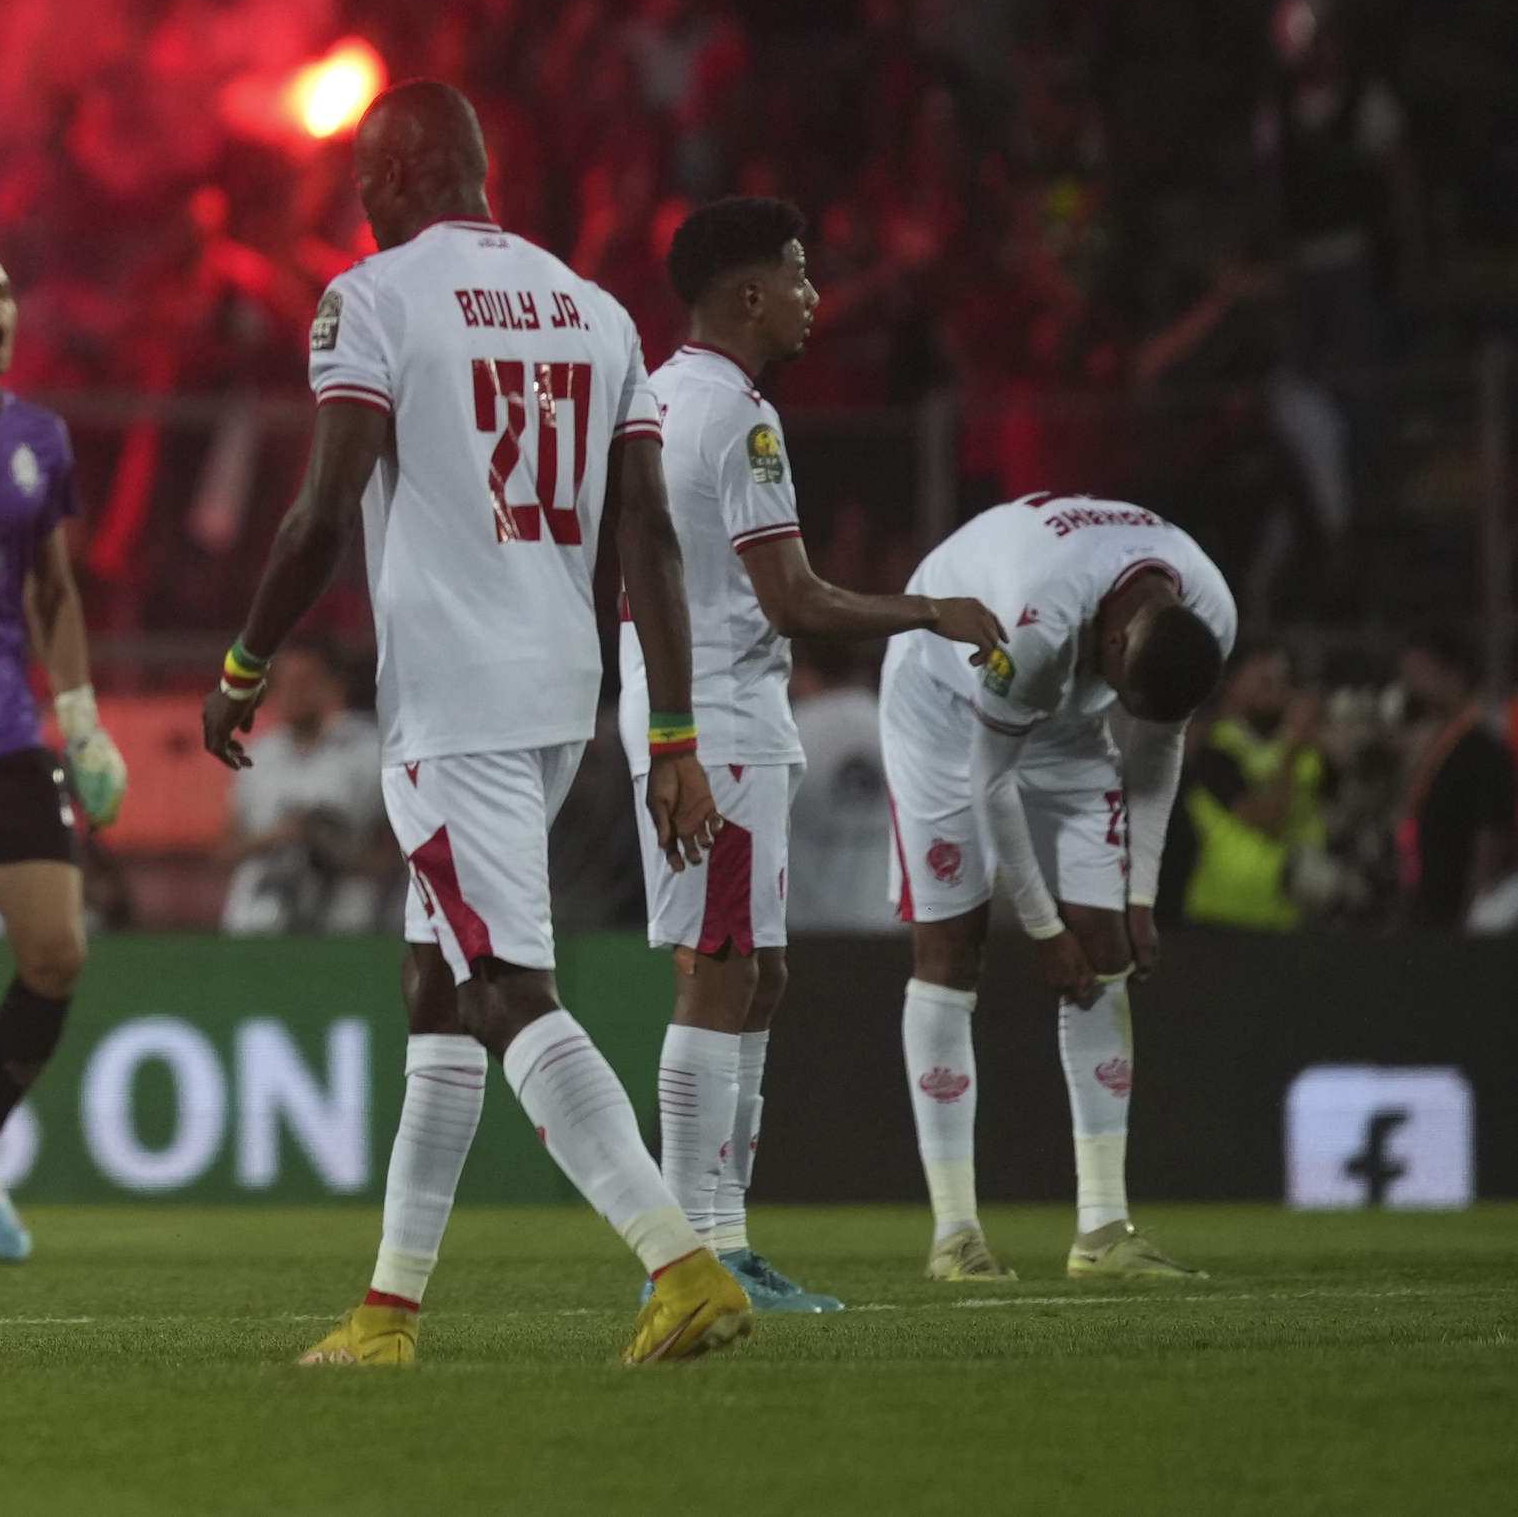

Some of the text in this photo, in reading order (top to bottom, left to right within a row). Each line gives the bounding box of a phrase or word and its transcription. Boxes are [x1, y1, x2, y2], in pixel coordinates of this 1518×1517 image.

[454, 288, 541, 331] BOULY
[471, 358, 592, 546] 20
[79, 1014, 371, 1195] ON
